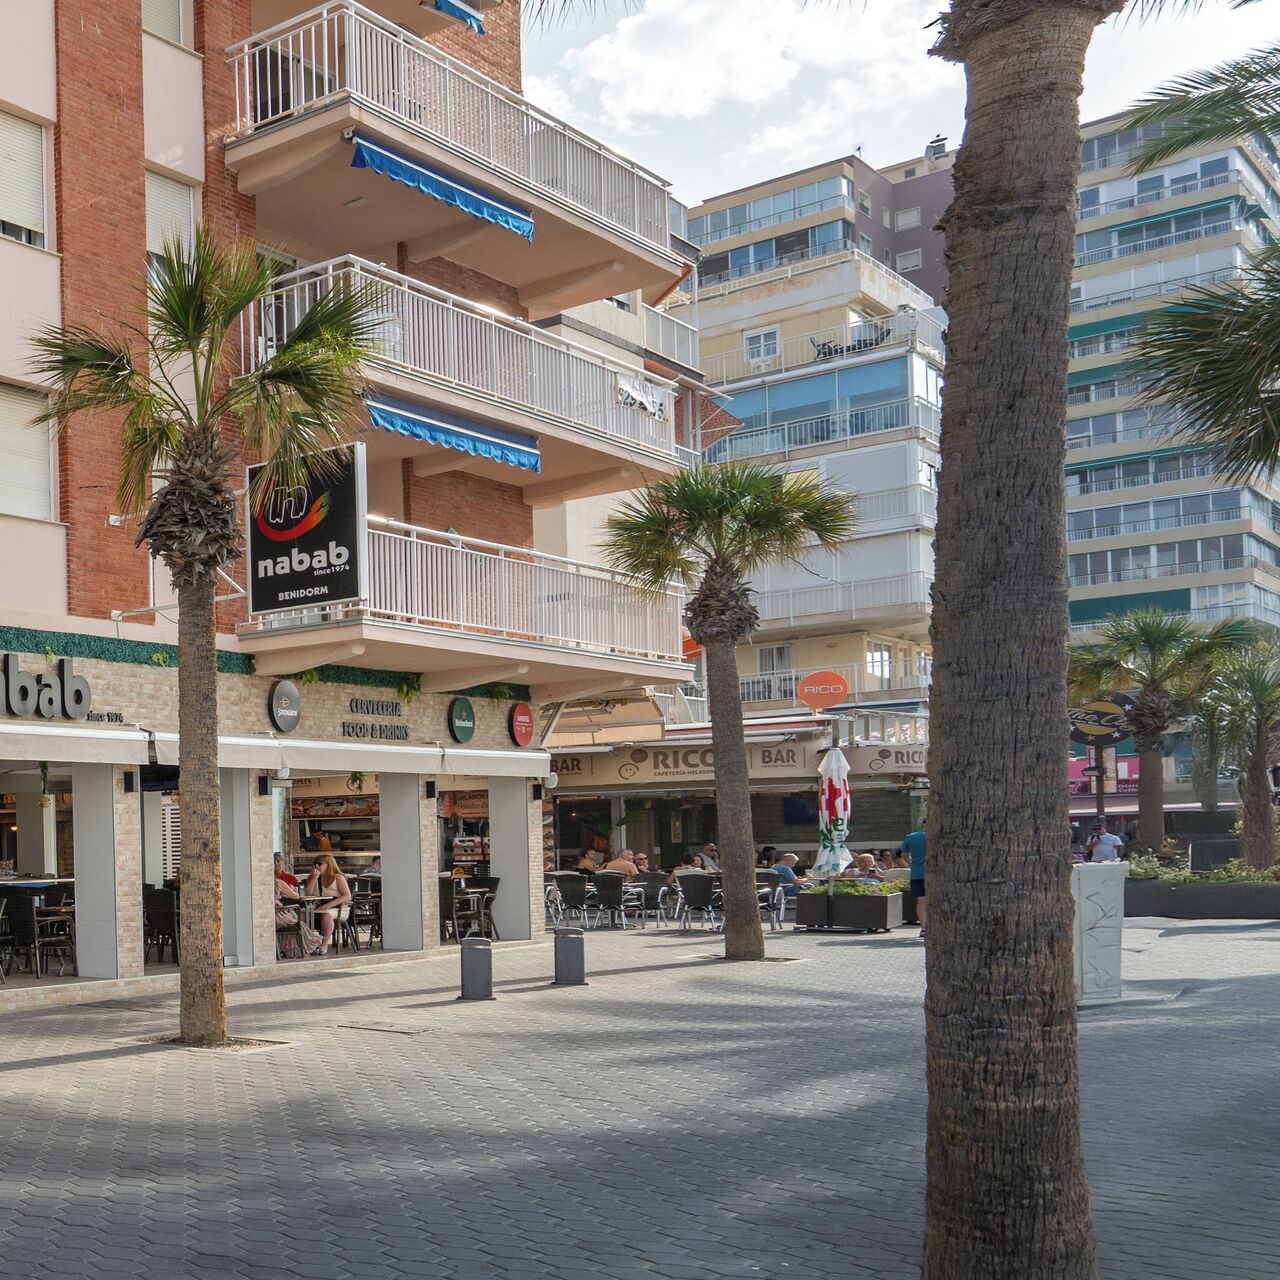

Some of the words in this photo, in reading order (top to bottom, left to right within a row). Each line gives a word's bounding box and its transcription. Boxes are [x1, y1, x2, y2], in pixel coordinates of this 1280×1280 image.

[258, 541, 350, 578] nabab
[313, 568, 331, 576] since
[331, 564, 350, 574] 1974
[278, 585, 329, 601] BENIDORM
[804, 685, 843, 694] RICO
[350, 698, 401, 717] CERVECERIA
[87, 710, 105, 722] since
[342, 721, 369, 738] FOOD
[371, 724, 378, 739] &
[380, 724, 410, 740] DRINKS
[653, 748, 715, 770] RICO
[761, 749, 797, 764] BAR
[550, 758, 582, 772] BAR
